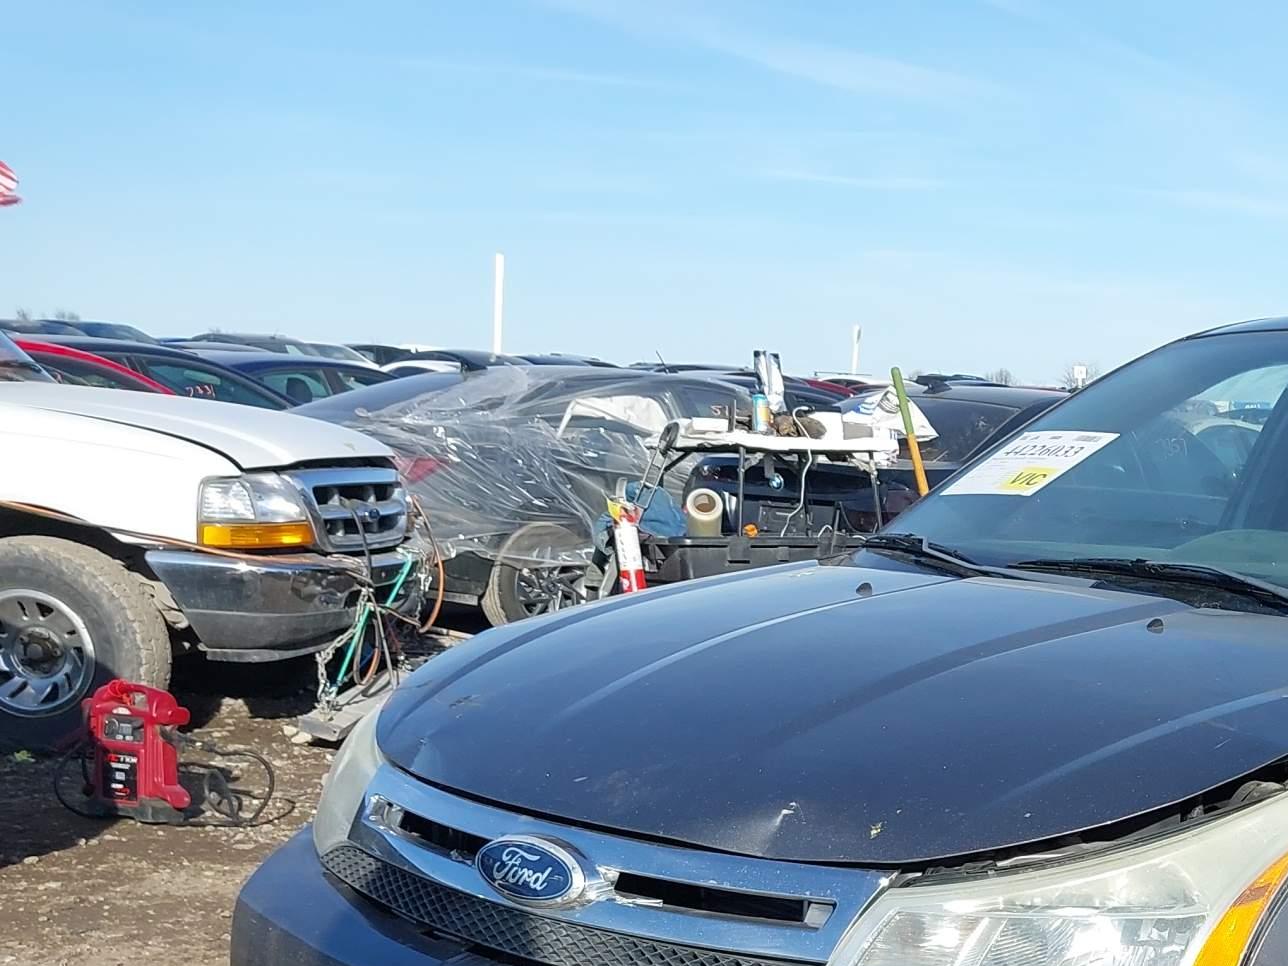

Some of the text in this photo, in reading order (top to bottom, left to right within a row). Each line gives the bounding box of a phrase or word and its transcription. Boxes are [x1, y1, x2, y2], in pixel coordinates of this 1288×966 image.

[1004, 444, 1085, 458] 44226033
[1009, 471, 1047, 486] VIC
[493, 847, 553, 890] Ford
